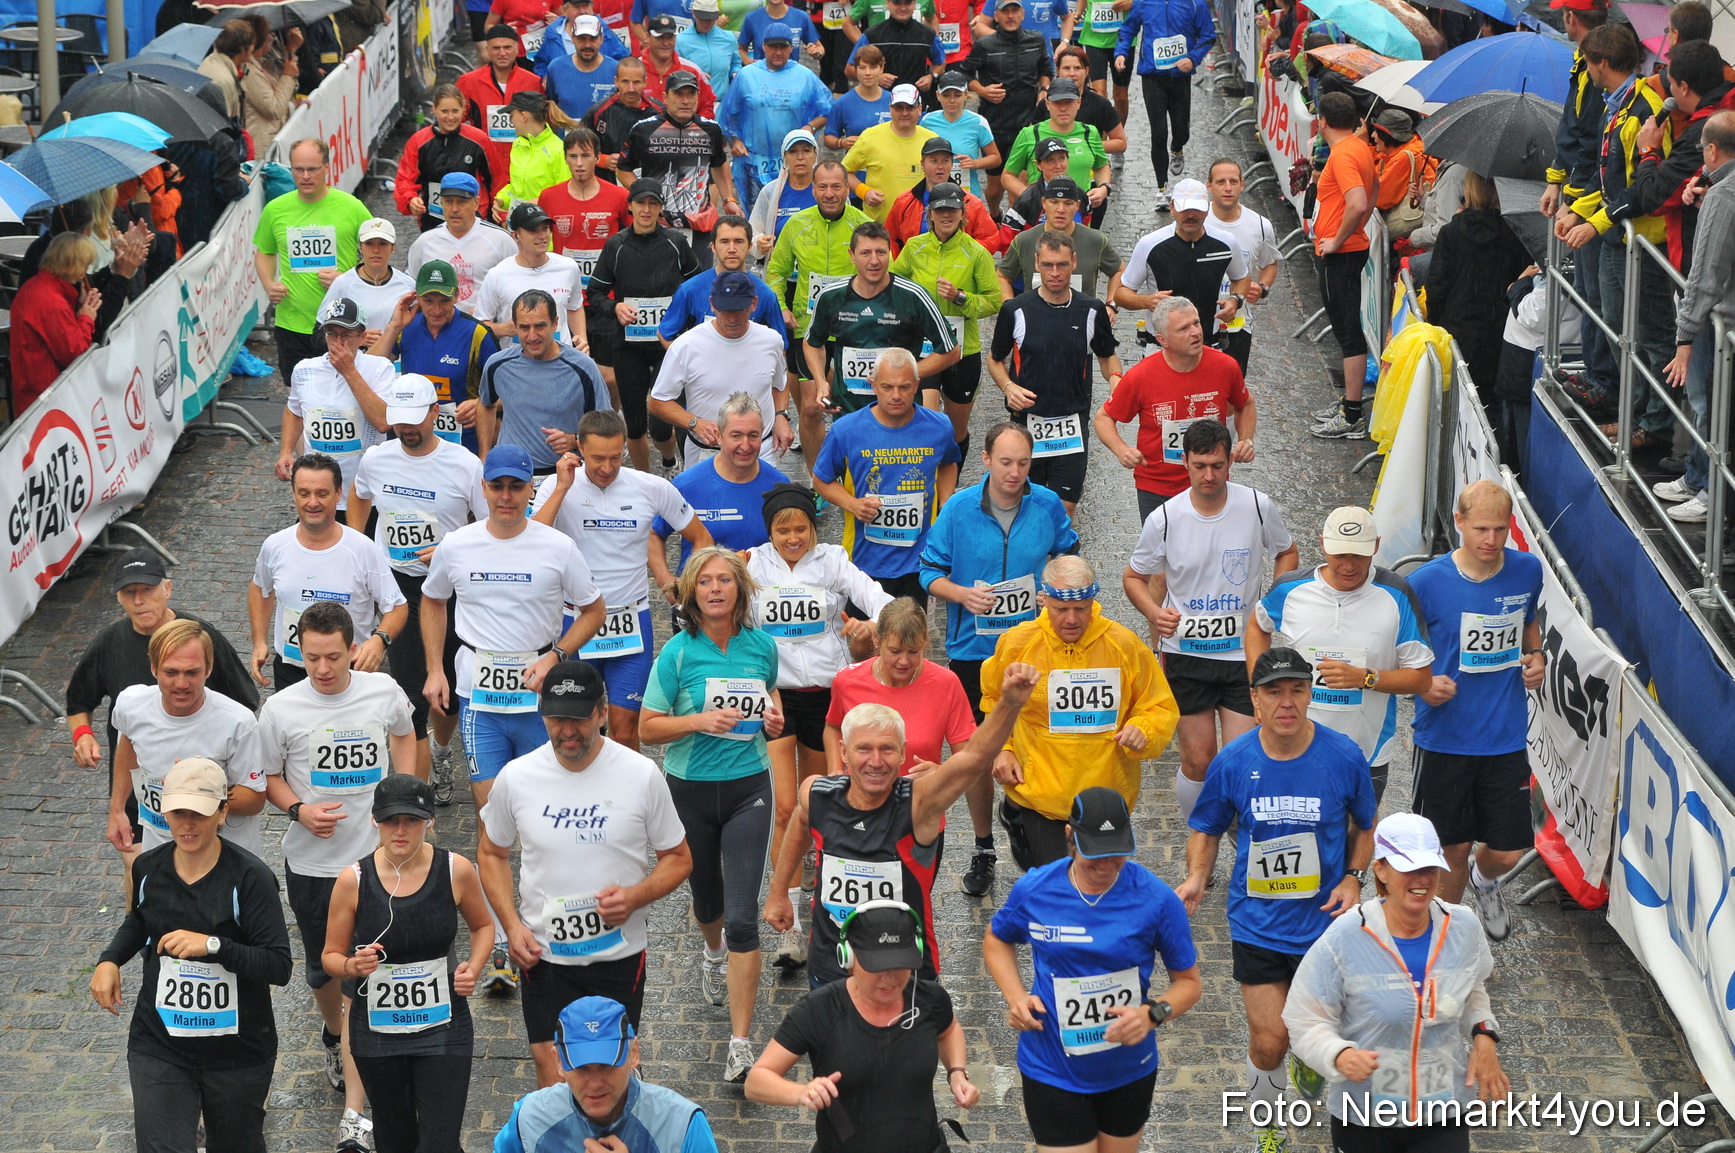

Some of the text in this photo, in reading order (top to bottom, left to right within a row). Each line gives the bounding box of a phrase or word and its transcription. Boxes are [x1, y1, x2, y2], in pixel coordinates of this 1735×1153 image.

[1094, 9, 1119, 21] 2891
[1157, 43, 1184, 58] 2625
[292, 239, 332, 256] 3302
[311, 421, 355, 440] 3099
[433, 415, 456, 432] 63
[1033, 420, 1075, 440] 3215
[860, 447, 934, 457] 10. NEUMARKTER
[1045, 441, 1068, 451] Rupert
[873, 456, 924, 465] STADTLAUF
[100, 467, 129, 503] SEAT
[871, 508, 918, 527] 2866
[387, 524, 435, 546] 2654
[883, 530, 905, 538] Klaus
[402, 550, 419, 559] Jen
[765, 600, 821, 622] 3046
[784, 626, 803, 635] Jina
[1184, 616, 1236, 639] 2520
[595, 640, 625, 650] Konrad
[1190, 641, 1231, 651] Ferdinand
[1466, 627, 1517, 651] 2314
[1471, 654, 1510, 665] Christoph
[1070, 672, 1099, 680] BOCK
[485, 693, 523, 705] Matthias
[1055, 685, 1115, 710] 3045
[1074, 714, 1096, 724] Rudi
[317, 742, 378, 770] 2653
[330, 775, 366, 785] Markus
[141, 784, 161, 813] 26
[1250, 795, 1321, 813] HUBER
[542, 804, 600, 818] Lauf
[1266, 811, 1318, 819] TECHNOLOGY
[552, 815, 609, 829] Treff
[1256, 851, 1302, 878] 147
[829, 876, 894, 904] 2619
[1269, 882, 1297, 891] Klaus
[180, 964, 210, 975] BOCK
[391, 966, 424, 976] BOCK
[164, 978, 230, 1010] 2860
[376, 977, 440, 1008] 2861
[173, 1013, 215, 1027] Martina
[392, 1012, 429, 1023] Sabine
